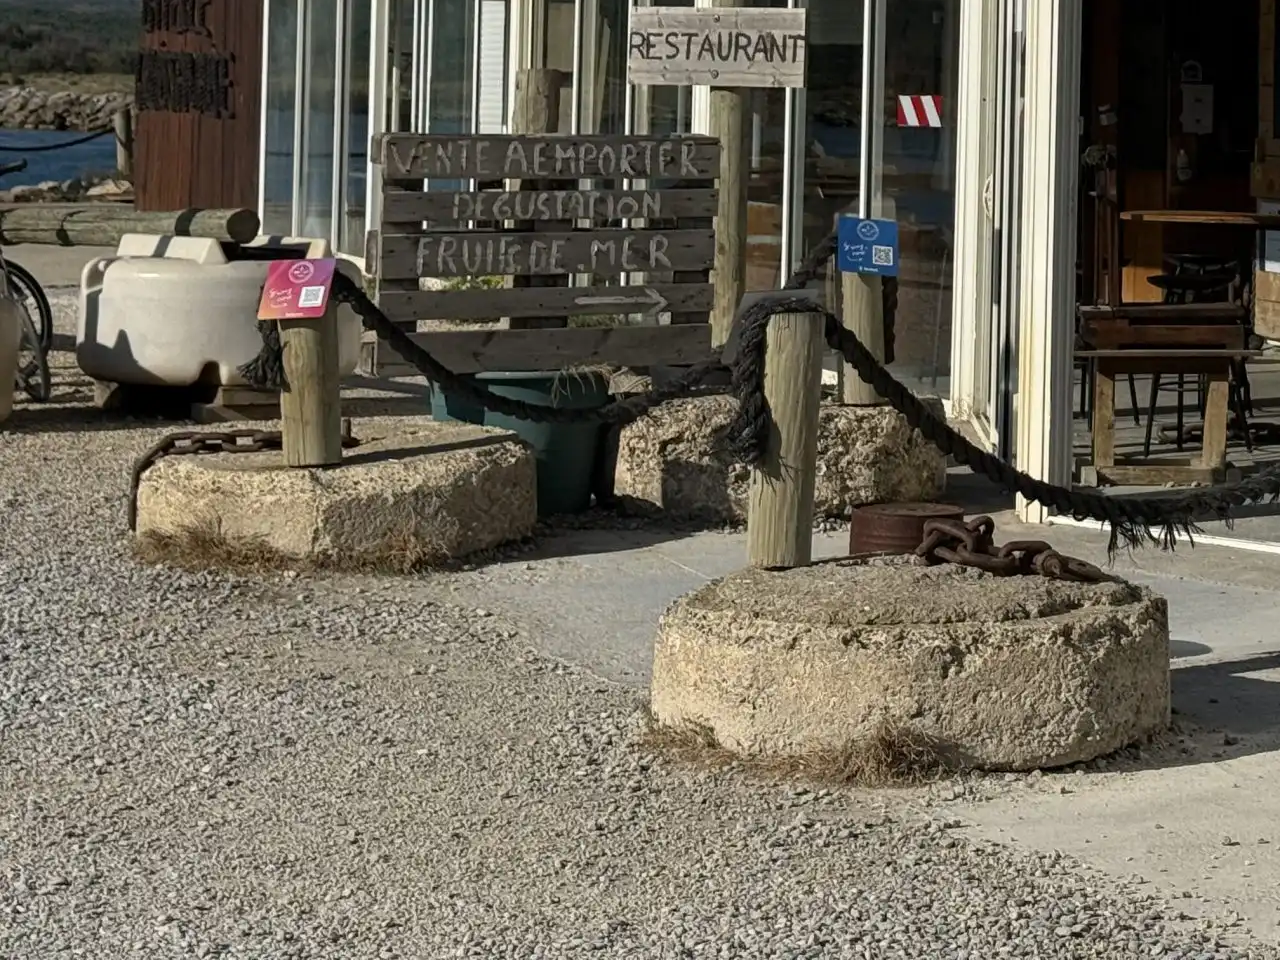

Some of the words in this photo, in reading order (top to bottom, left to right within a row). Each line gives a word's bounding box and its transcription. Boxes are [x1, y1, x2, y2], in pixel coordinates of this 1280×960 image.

[629, 31, 806, 64] RESTAURANT
[453, 191, 661, 221] DEGUSTATION
[590, 233, 672, 270] MER
